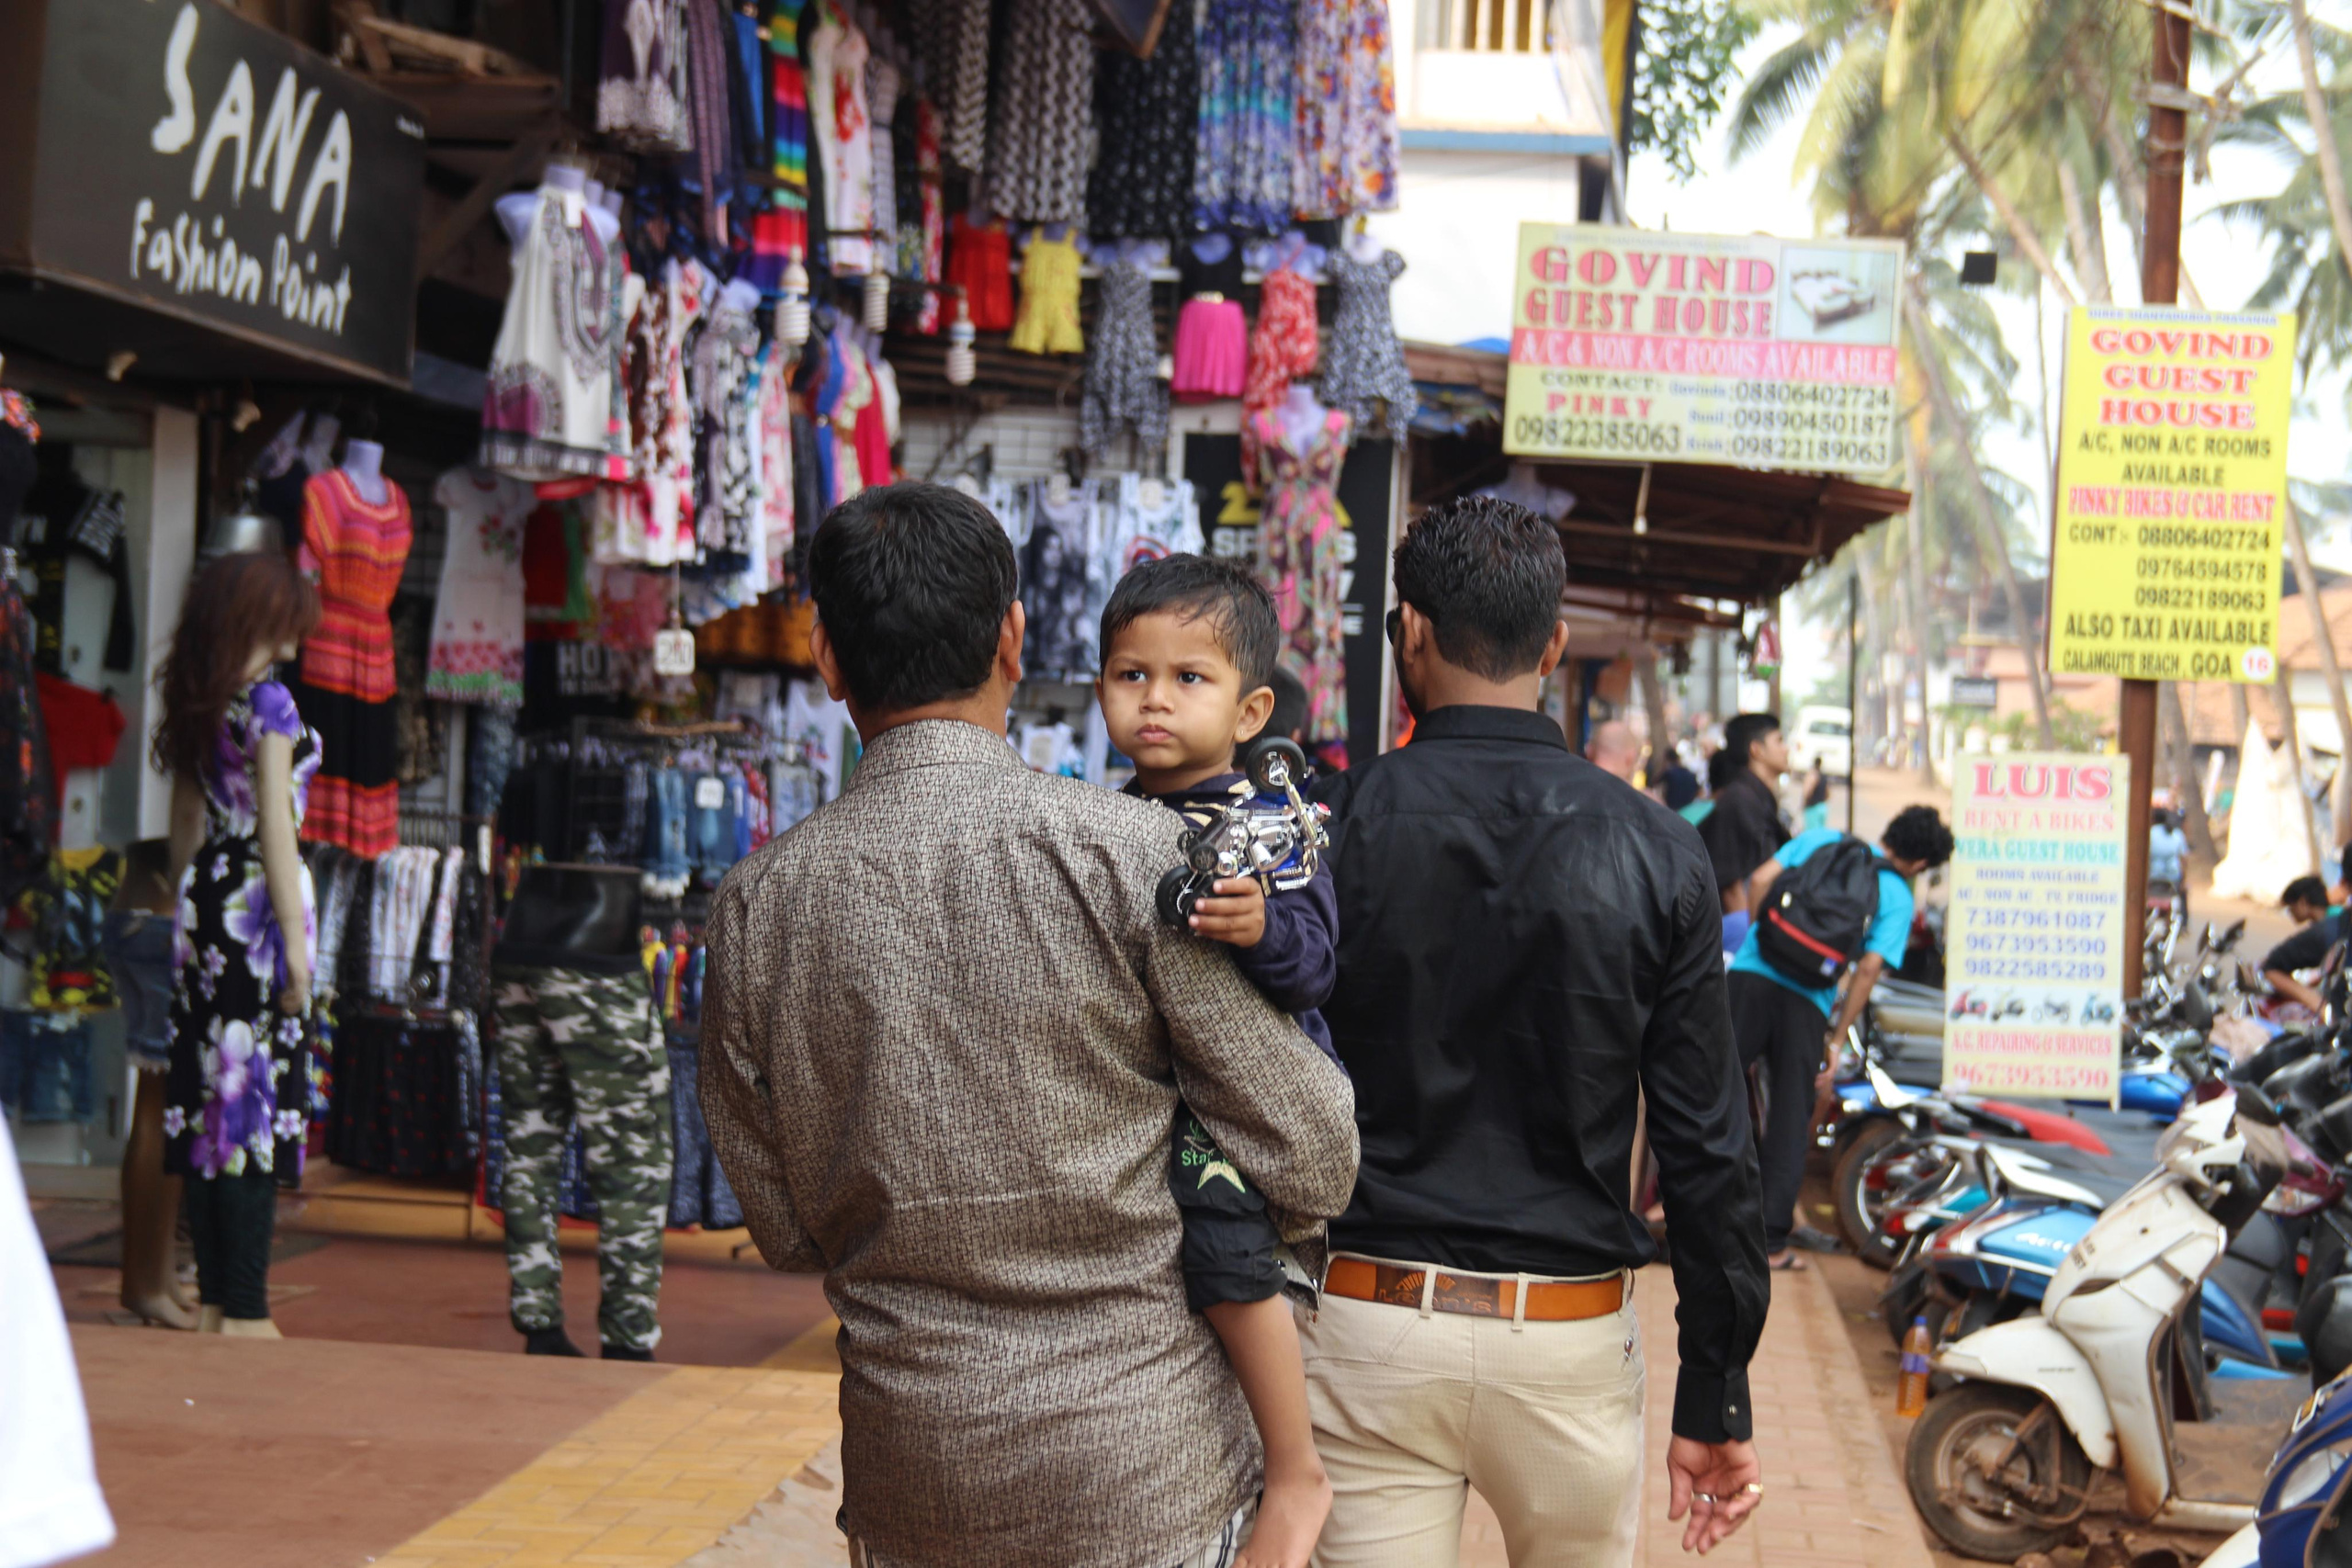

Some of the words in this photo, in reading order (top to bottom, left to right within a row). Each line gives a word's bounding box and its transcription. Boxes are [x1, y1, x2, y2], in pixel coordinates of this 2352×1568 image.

[152, 3, 352, 248] SANA
[130, 197, 263, 305] Fashion
[270, 232, 352, 336] Point
[1530, 246, 1775, 296] GOVIND
[1524, 288, 1639, 329] GUEST
[1655, 296, 1772, 337] HOUSE
[1520, 330, 1563, 366] A/C
[1591, 335, 1634, 367] NON
[1639, 338, 1683, 371] A/C
[1685, 340, 1756, 374] ROOMS
[1762, 344, 1892, 382] AVAILABLE
[2090, 329, 2272, 360] GOVIND
[2103, 365, 2256, 395] GUEST
[1547, 392, 1653, 419] PINKY
[2099, 398, 2256, 429] HOUSE
[1514, 414, 1680, 453] 09822385063
[2078, 432, 2113, 454] A/C,
[2121, 434, 2160, 454] NON
[2168, 434, 2196, 455] A/C
[2204, 437, 2271, 457] ROOMS
[2121, 465, 2224, 487] AVAILABLE
[2068, 487, 2120, 515] PINKY
[2124, 489, 2173, 518] BIKES
[2192, 491, 2226, 520] CAR
[2230, 493, 2276, 522] RENT
[2138, 525, 2270, 549] 08806402724
[2134, 587, 2267, 611] 09822189063
[2064, 613, 2113, 639] ALSO
[2121, 615, 2161, 640] TAXI
[2168, 617, 2271, 645] AVAILABLE
[2064, 648, 2134, 673] CALANGUTE
[2191, 652, 2233, 677] GOA
[1973, 762, 2111, 800] LUIS
[1963, 809, 2020, 830] RENT
[2029, 811, 2041, 830] A
[2049, 811, 2114, 831] BIKES
[2005, 839, 2060, 862] GUEST
[2064, 841, 2120, 864] HOUSE
[1977, 1030, 2040, 1055] REPAIRING
[2054, 1033, 2111, 1056] SERVICES
